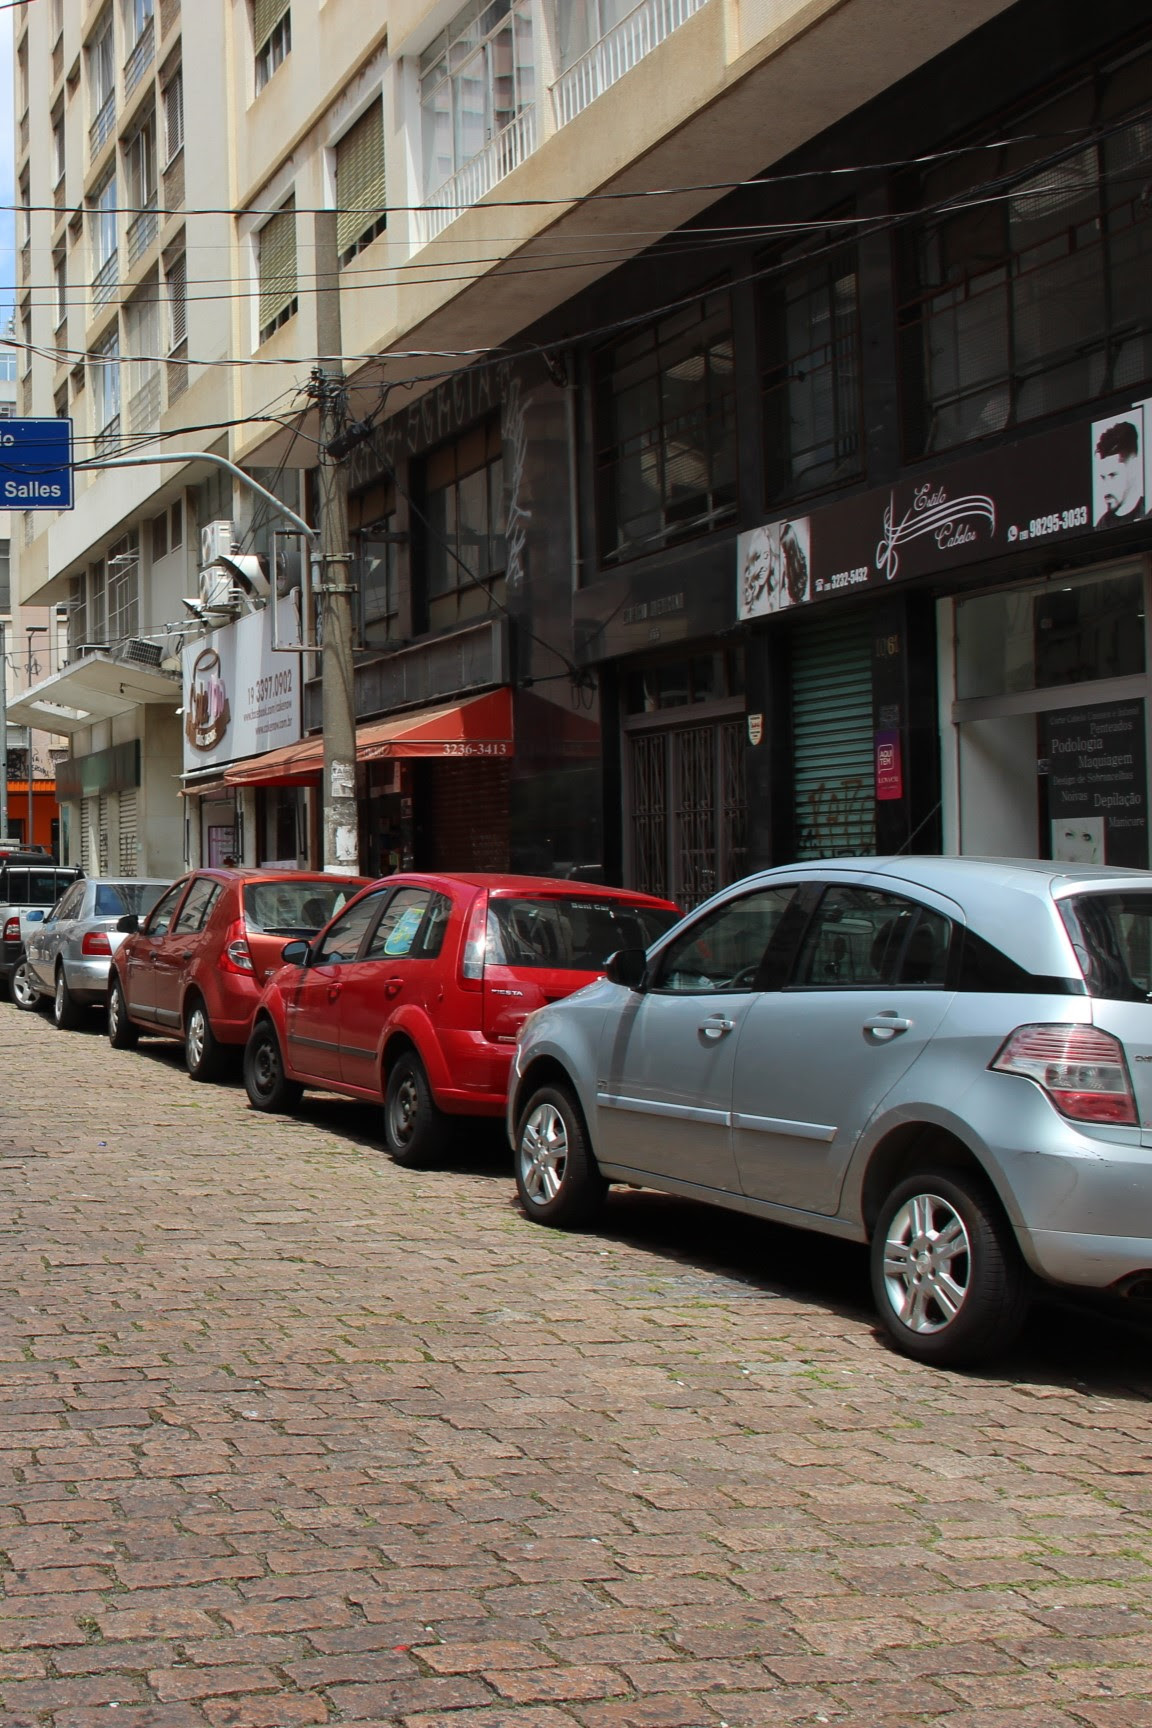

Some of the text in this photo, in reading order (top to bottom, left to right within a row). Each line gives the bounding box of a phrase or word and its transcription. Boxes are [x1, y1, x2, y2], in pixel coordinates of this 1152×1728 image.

[4, 480, 62, 499] Salles
[1029, 505, 1088, 538] 98295-3033
[934, 520, 977, 551] Cabelos
[831, 566, 868, 590] 3232-5432
[247, 686, 255, 705] 19
[255, 668, 293, 703] 3397.0902
[442, 743, 507, 756] 3236-3413
[1051, 734, 1104, 754] Podologia
[1078, 752, 1133, 769] Maquiagem
[1093, 791, 1142, 808] Depilação
[490, 988, 524, 997] FIESTA
